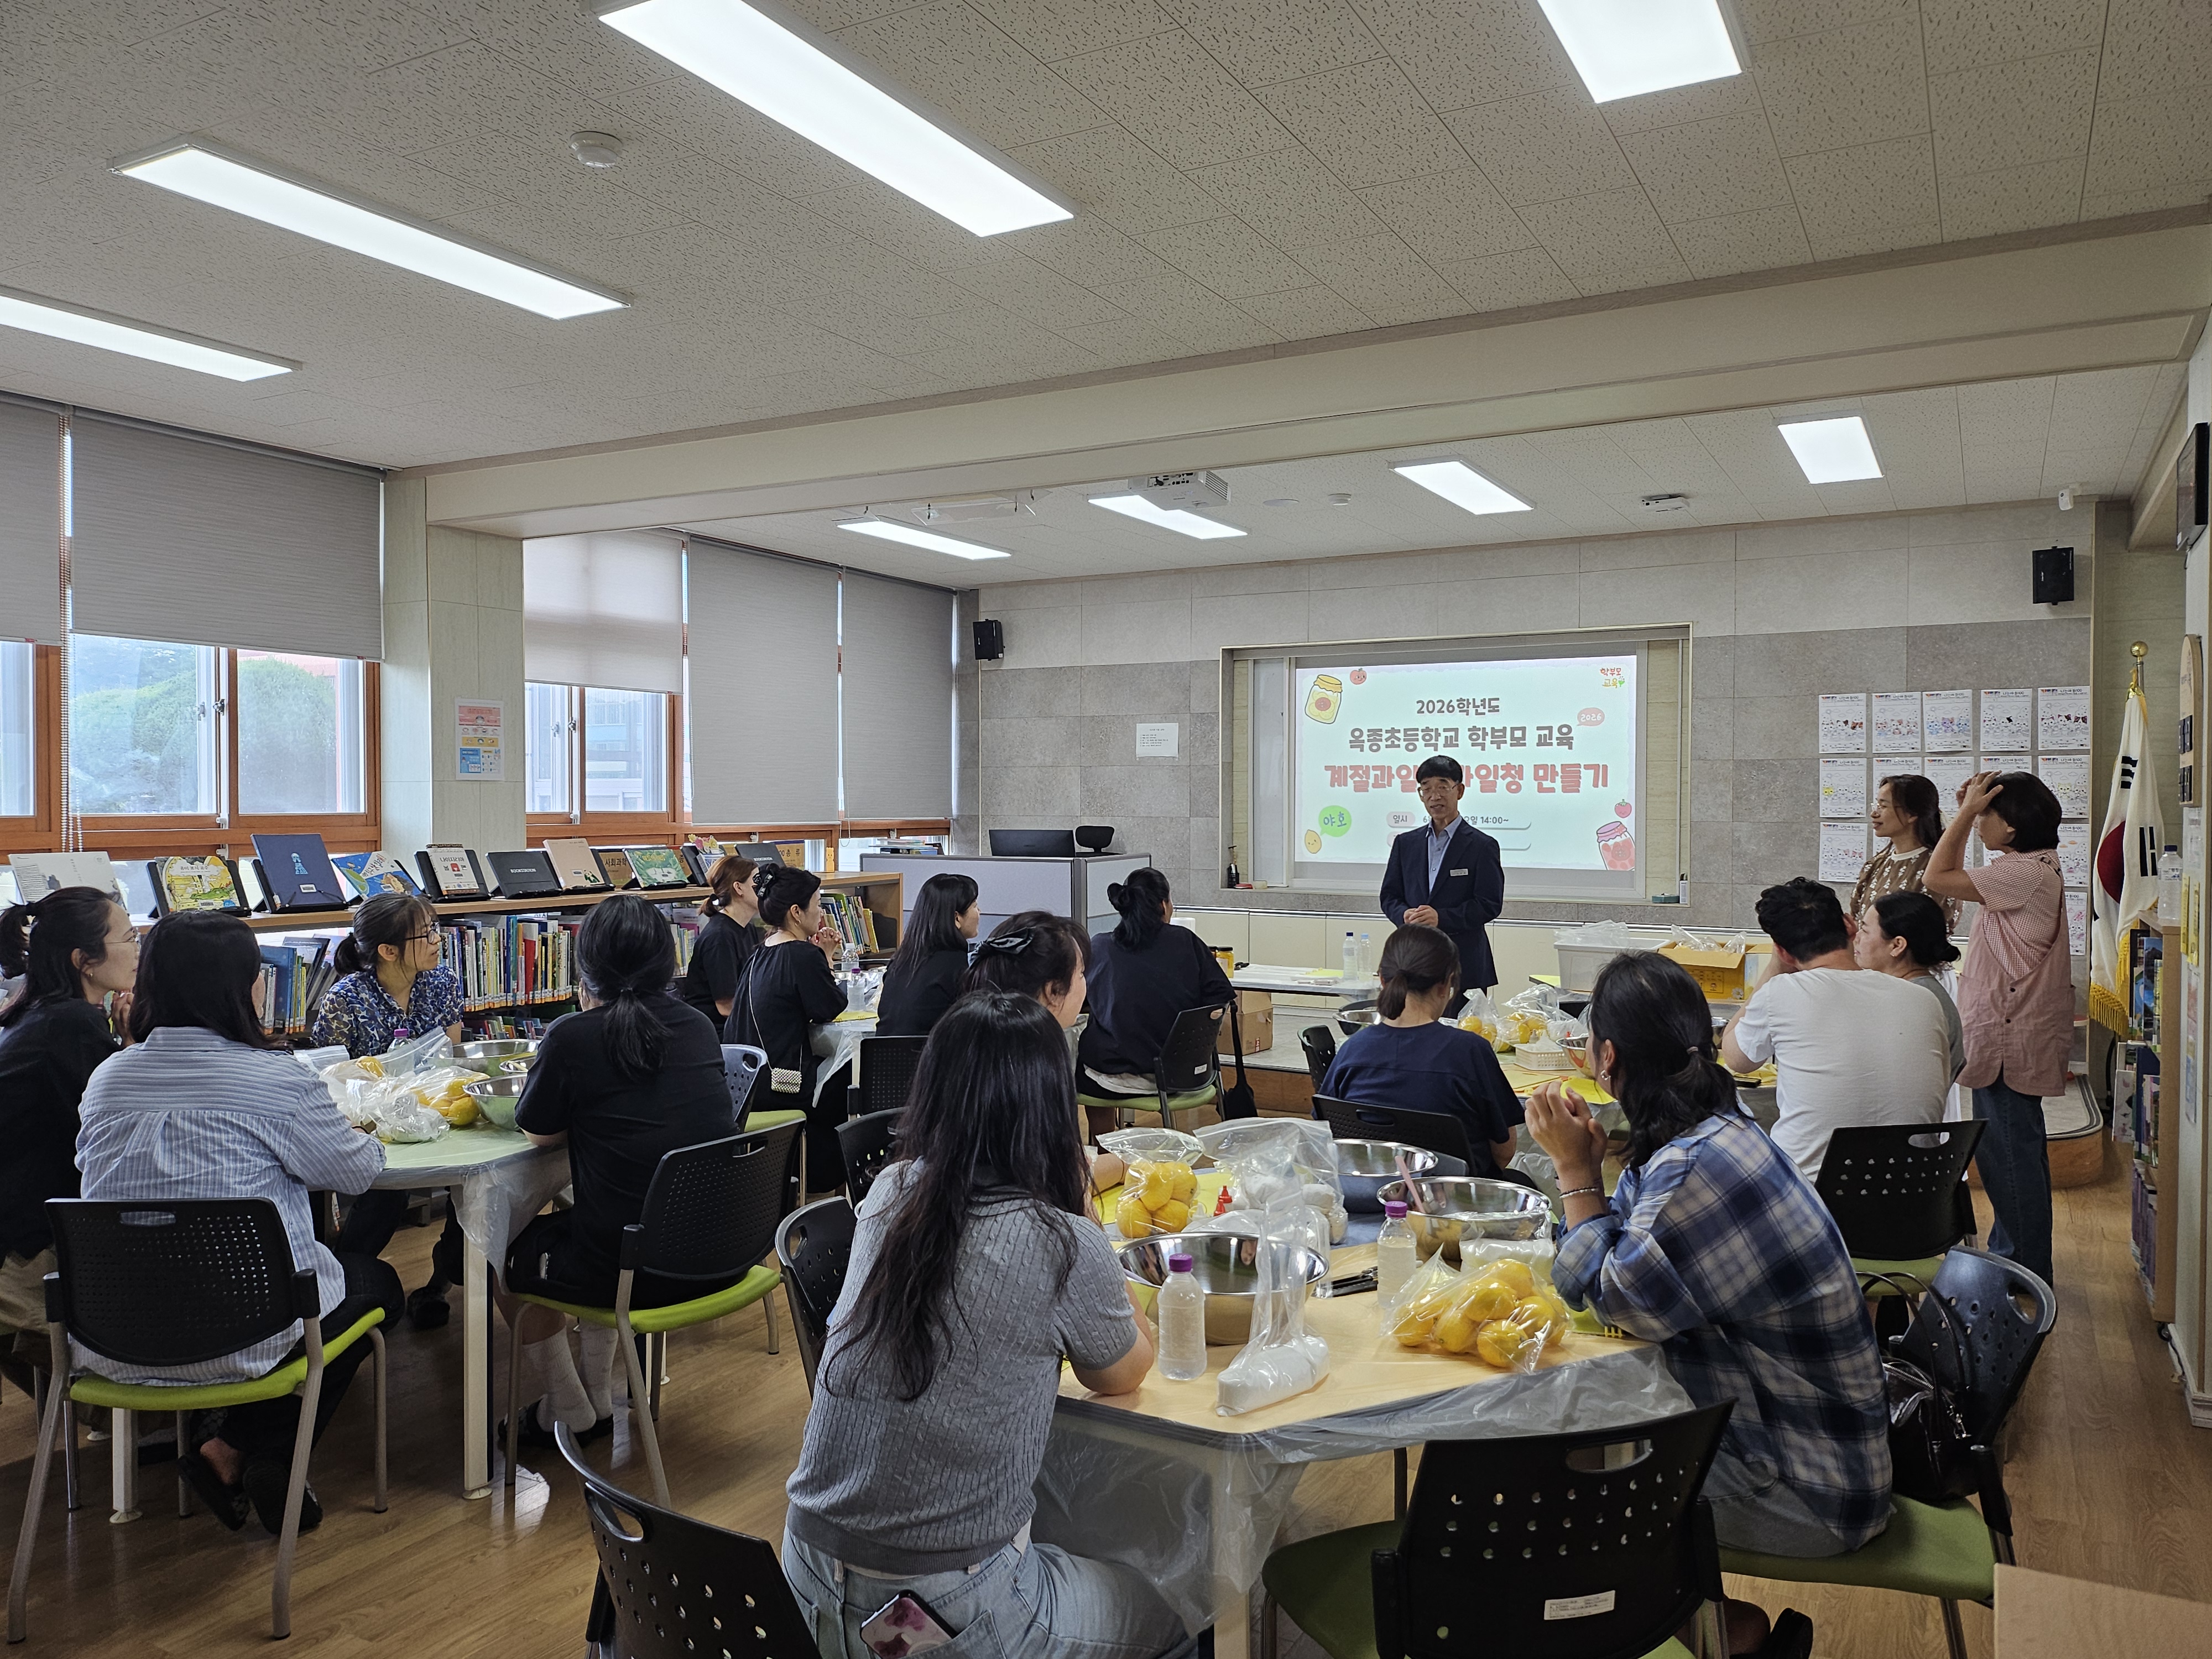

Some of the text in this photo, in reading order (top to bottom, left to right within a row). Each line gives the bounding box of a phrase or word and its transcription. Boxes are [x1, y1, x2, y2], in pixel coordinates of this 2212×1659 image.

[1599, 667, 1621, 676] 학부모
[1602, 678, 1618, 688] 교육
[1416, 698, 1500, 716] 2026학년도
[1580, 713, 1602, 722] 2026
[1349, 724, 1574, 752] 옥종초등학교 학부모 교육
[1533, 763, 1609, 794] 만들기
[1392, 815, 1407, 823] 일시
[605, 858, 627, 867] 사회과학
